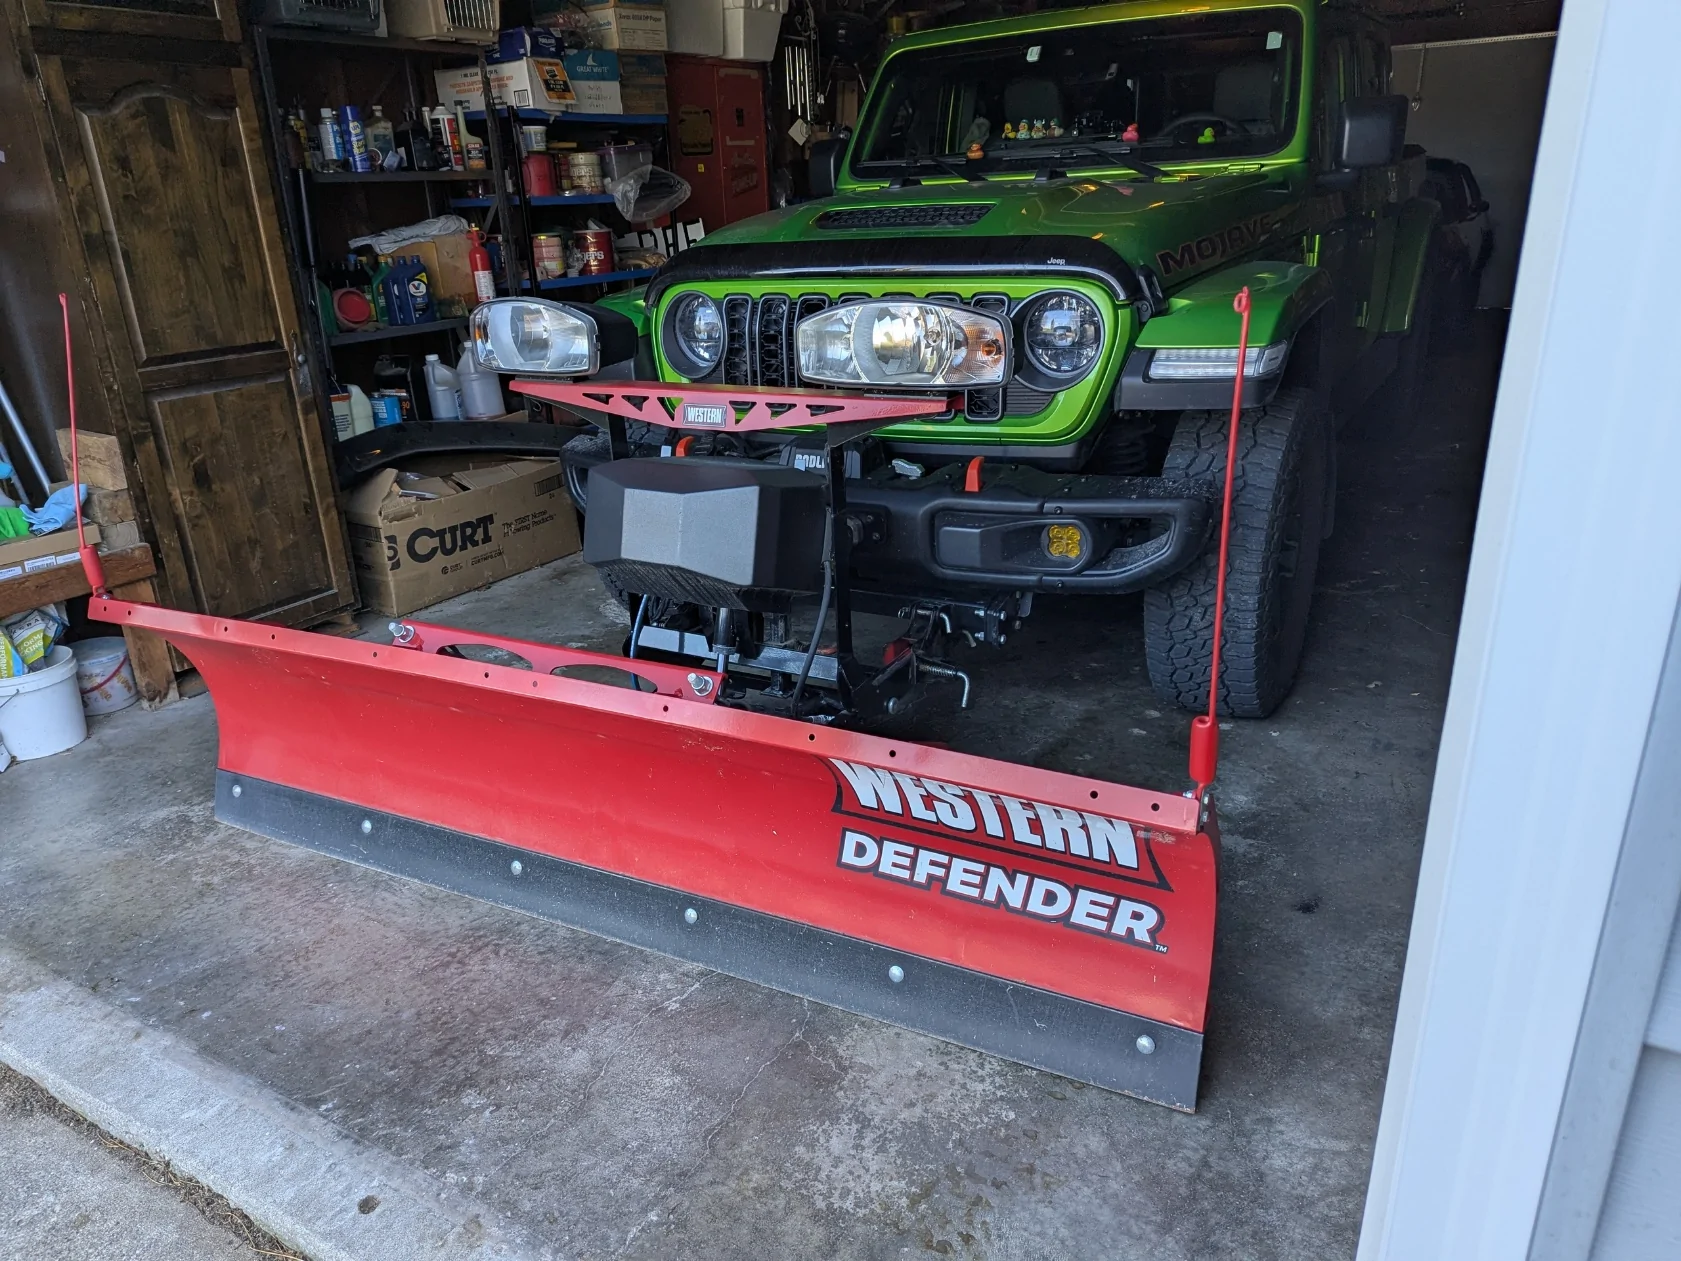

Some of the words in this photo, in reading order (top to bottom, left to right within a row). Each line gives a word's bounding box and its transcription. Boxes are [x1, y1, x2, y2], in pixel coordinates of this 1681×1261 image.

[1047, 257, 1066, 266] Jeep
[1156, 215, 1271, 277] MOJAVE
[687, 407, 722, 424] WESTERN
[531, 509, 548, 519] Name
[532, 515, 554, 528] Products
[407, 514, 494, 563] CURT
[829, 758, 1138, 869] WESTERN
[840, 829, 1160, 944] DEFENDER
